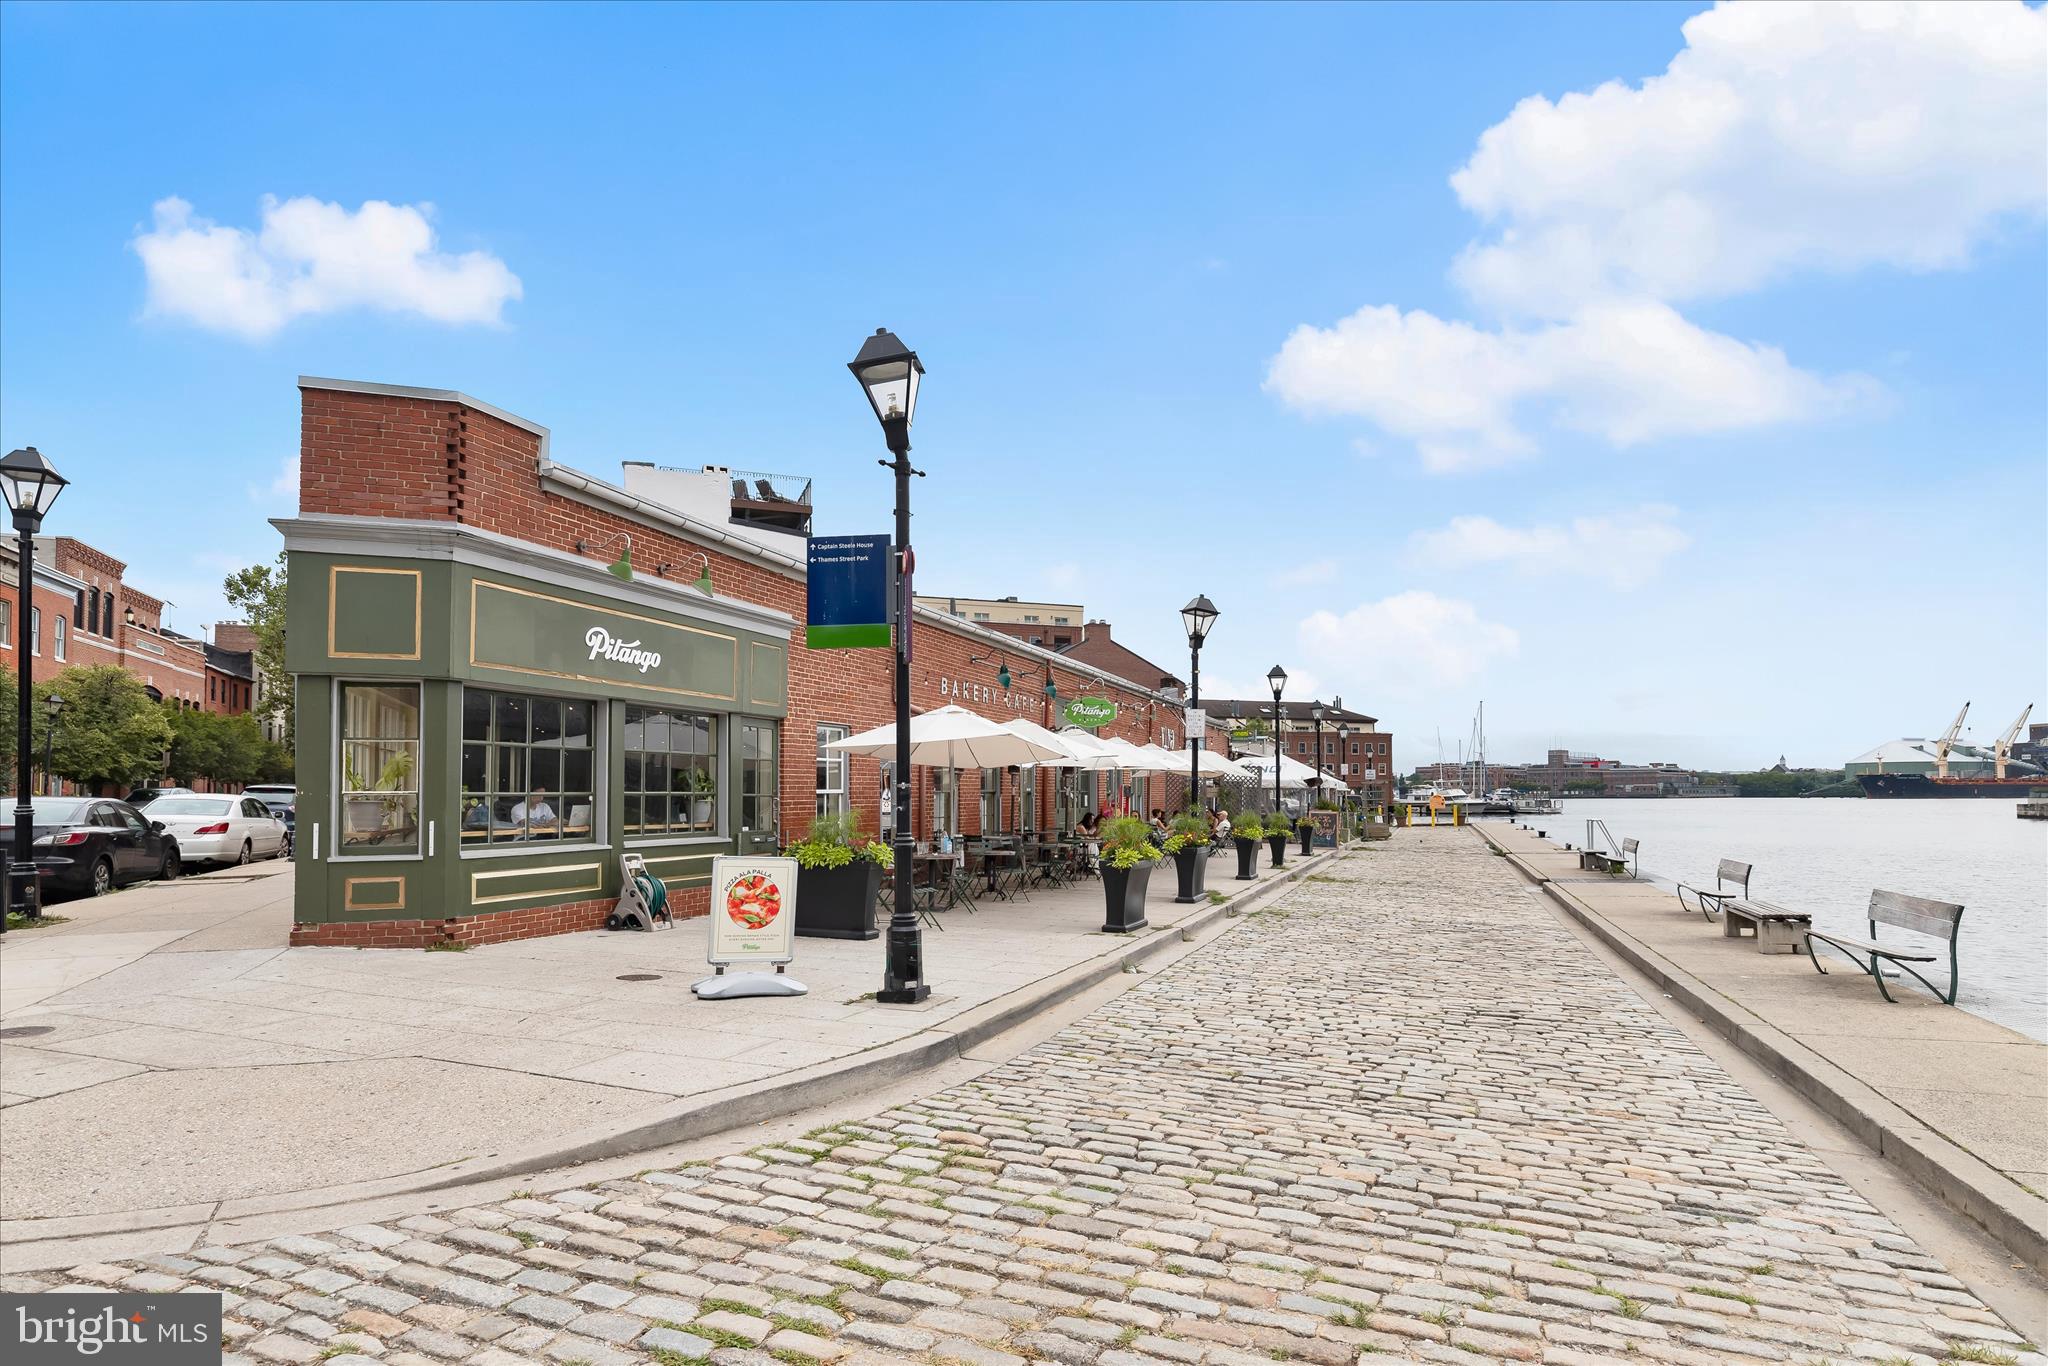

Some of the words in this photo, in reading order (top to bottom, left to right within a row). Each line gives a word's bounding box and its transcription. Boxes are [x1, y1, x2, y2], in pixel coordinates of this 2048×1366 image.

[585, 626, 662, 674] Pitango
[941, 677, 998, 705] BAKERY
[1004, 691, 1034, 713] CAFE
[1071, 703, 1111, 718] Pitango
[724, 875, 739, 892] PIZZA
[739, 869, 752, 878] ALA
[752, 869, 772, 879] PALLA
